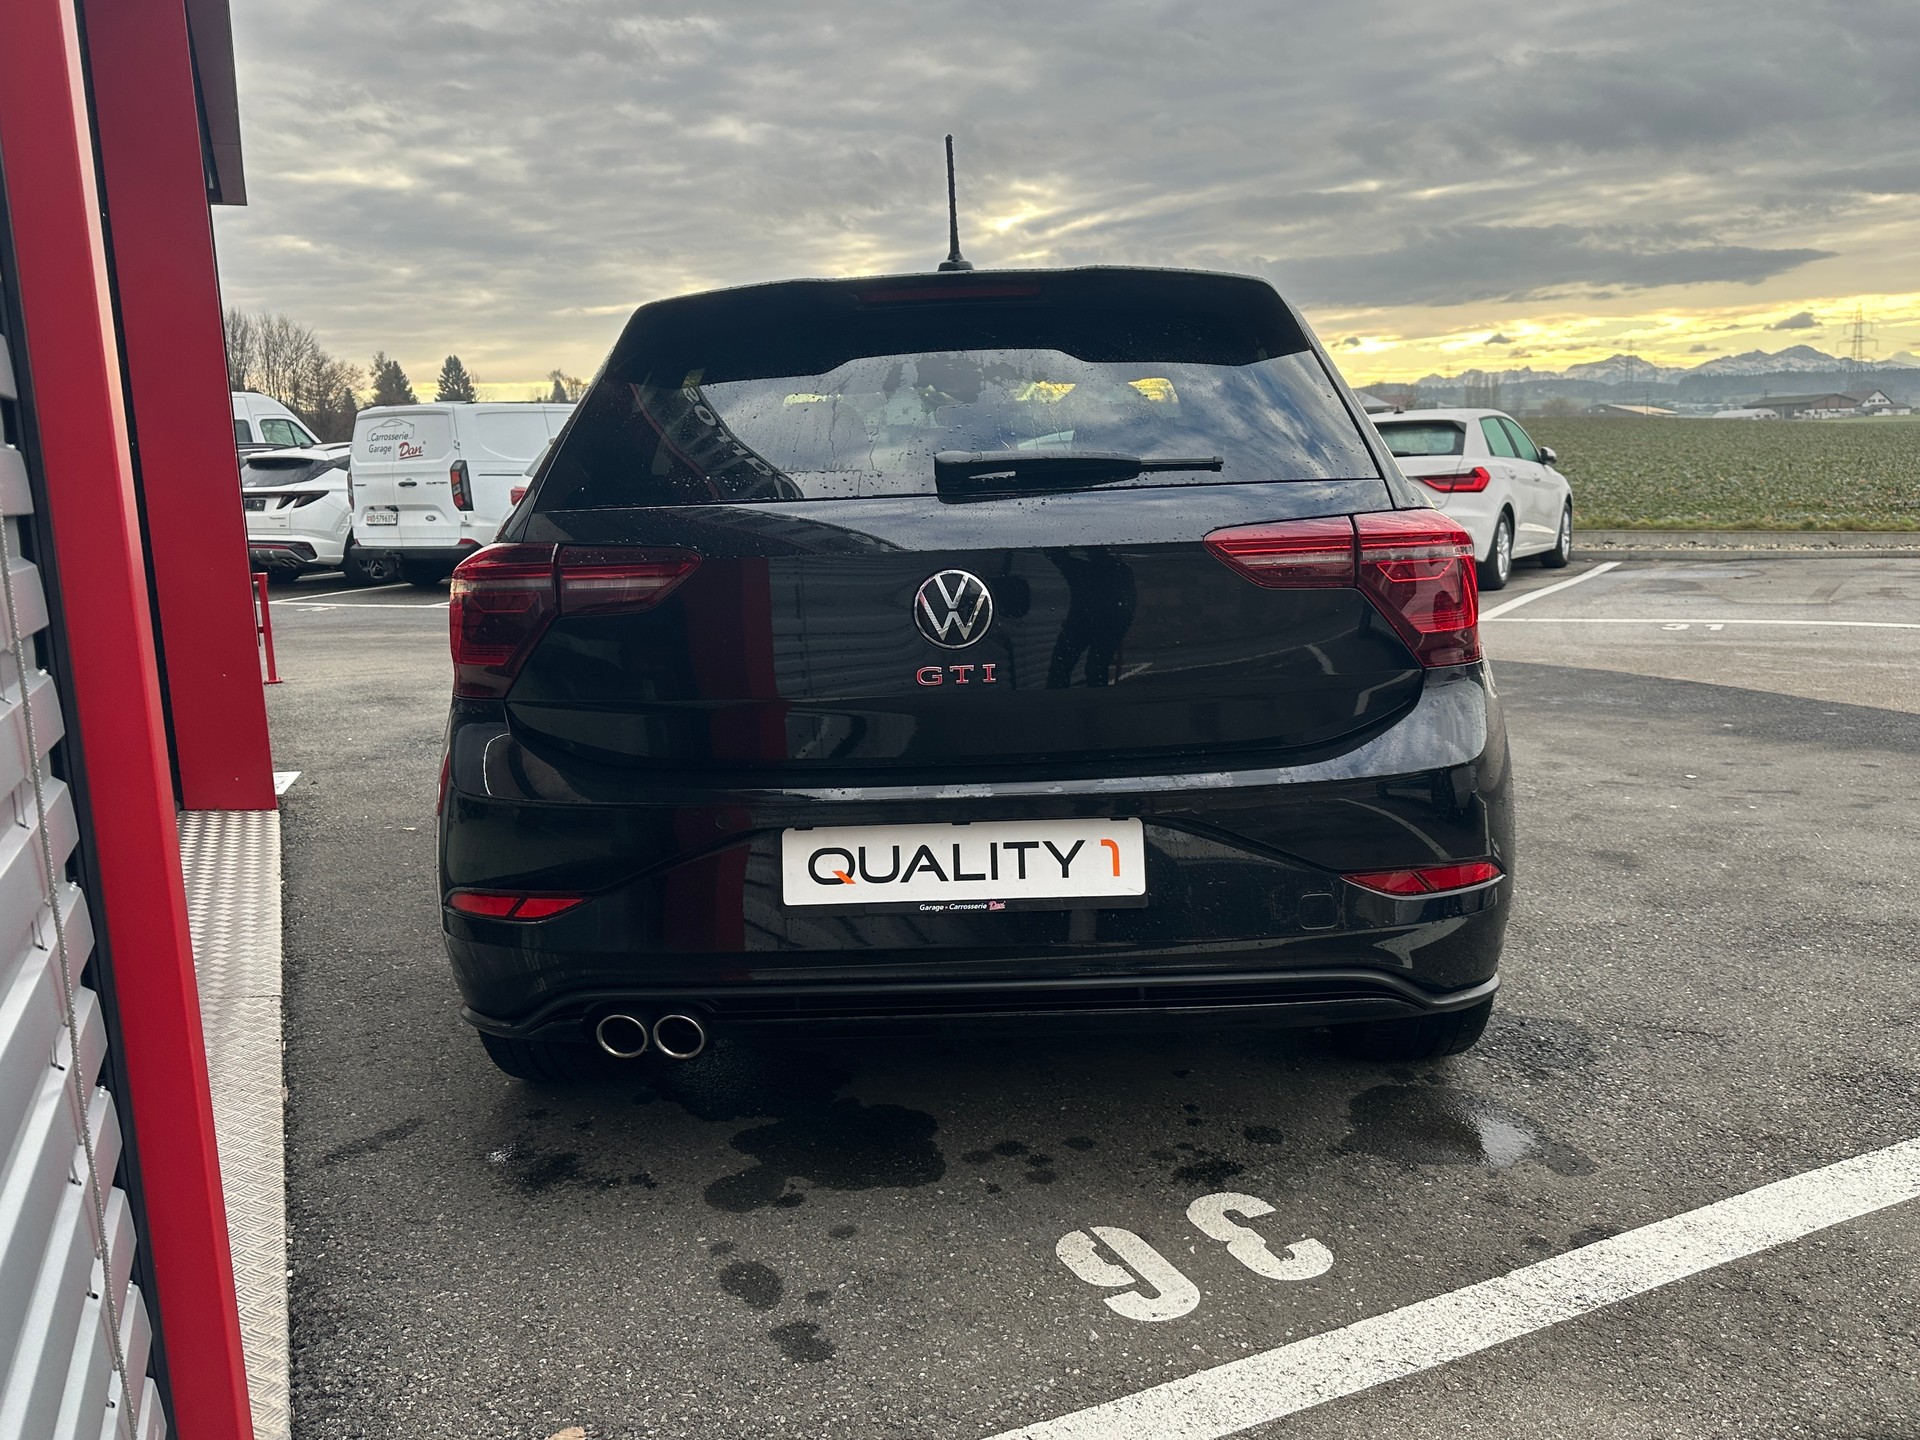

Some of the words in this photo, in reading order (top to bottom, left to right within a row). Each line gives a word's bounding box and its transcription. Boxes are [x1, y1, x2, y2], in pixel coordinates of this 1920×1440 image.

[370, 431, 409, 441] Carrosserie
[368, 445, 392, 455] Garage
[398, 441, 424, 457] Dan
[916, 663, 997, 686] GTI
[807, 838, 1087, 886] QUALITY
[919, 904, 945, 912] Garage
[949, 902, 988, 911] Carrosserie
[1055, 1191, 1334, 1322] 36
